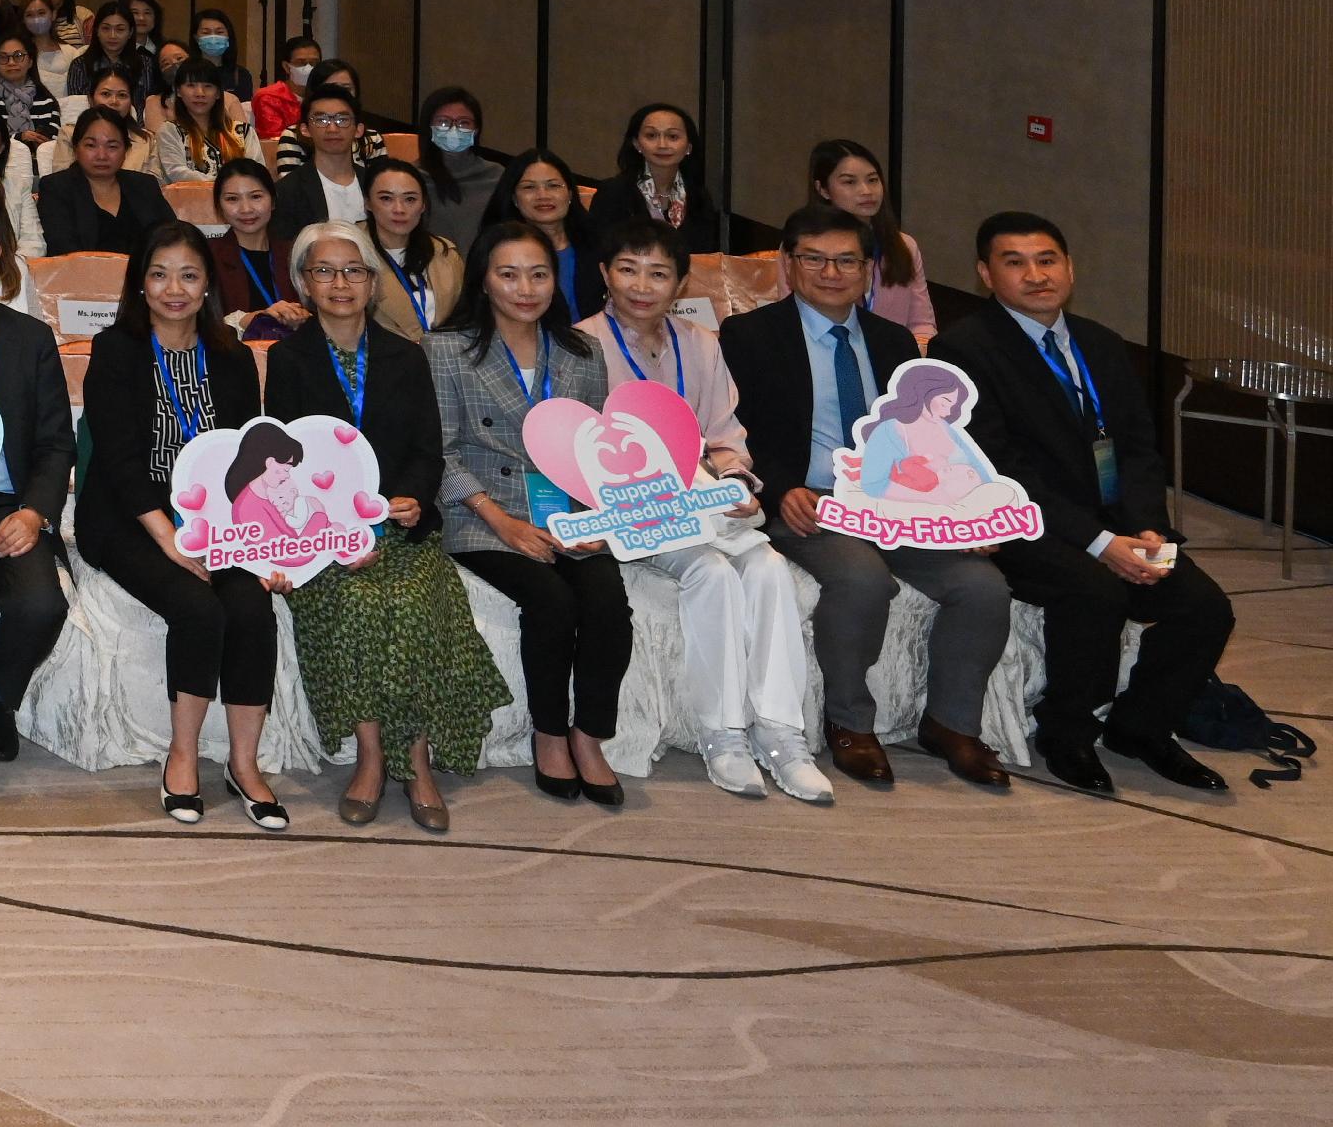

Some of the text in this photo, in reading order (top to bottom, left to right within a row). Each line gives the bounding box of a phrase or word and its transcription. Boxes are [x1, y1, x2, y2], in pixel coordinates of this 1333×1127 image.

[90, 311, 109, 319] Joyce
[601, 475, 678, 505] Support
[557, 498, 686, 539] Breastfeeding
[684, 486, 741, 508] Mums
[822, 503, 1038, 542] Baby-Friendly
[211, 524, 261, 545] Love
[618, 518, 701, 548] Together
[209, 531, 361, 568] Breastfeeding
